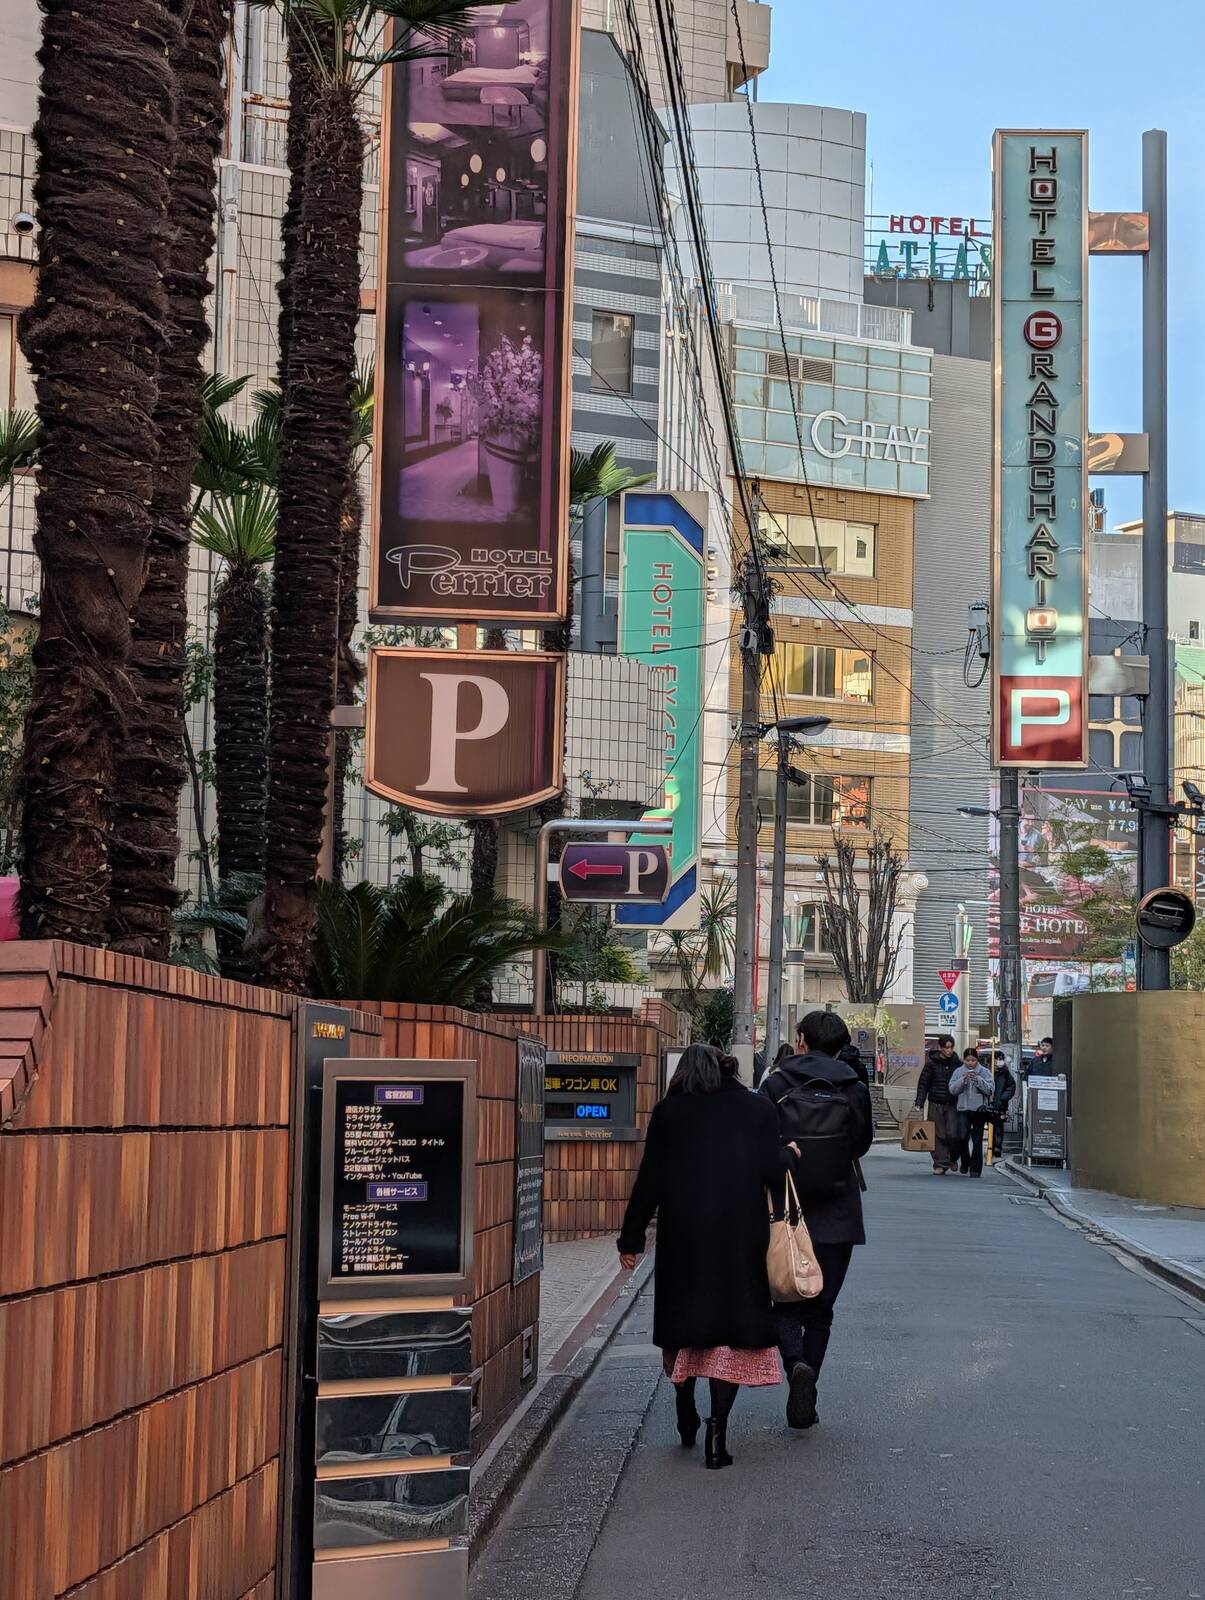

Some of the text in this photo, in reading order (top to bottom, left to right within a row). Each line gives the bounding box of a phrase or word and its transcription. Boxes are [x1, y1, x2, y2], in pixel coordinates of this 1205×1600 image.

[889, 214, 985, 237] HOTEL
[1028, 146, 1058, 297] HOTEL
[385, 544, 552, 598] Perrier
[471, 548, 553, 564] HOTEL
[651, 562, 674, 655] HOTEL
[415, 672, 510, 793] P
[1010, 689, 1071, 747] P
[625, 850, 659, 895] P
[559, 1054, 614, 1064] INFORMATION
[576, 1104, 608, 1118] OPEN
